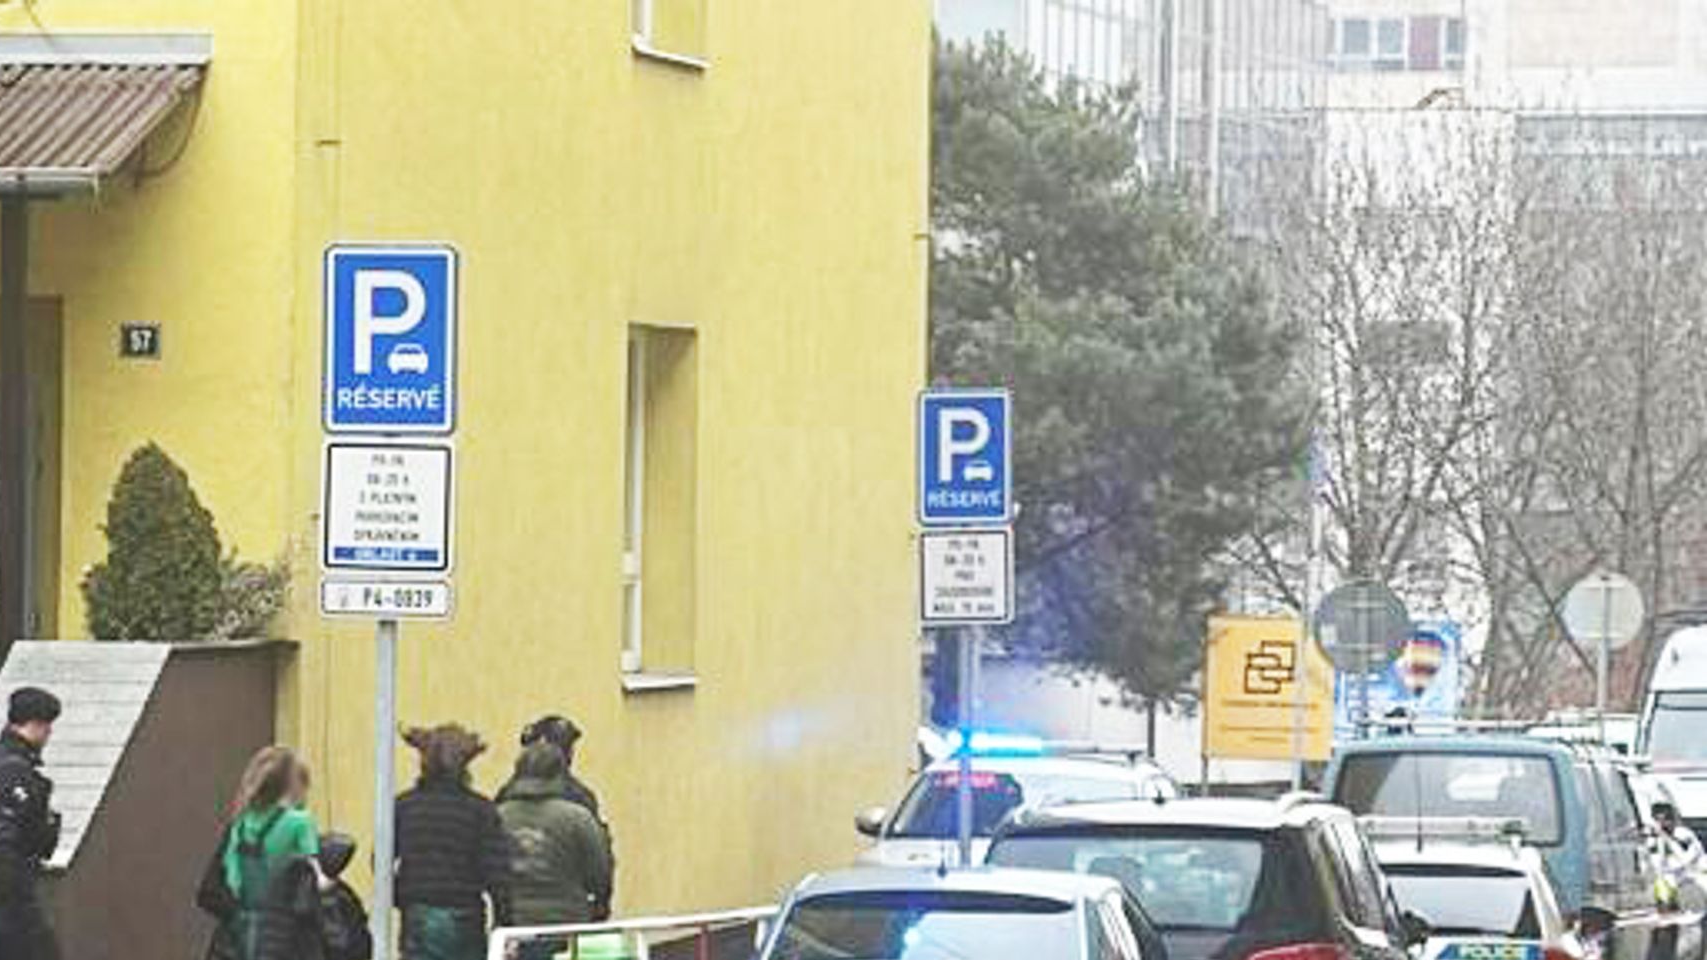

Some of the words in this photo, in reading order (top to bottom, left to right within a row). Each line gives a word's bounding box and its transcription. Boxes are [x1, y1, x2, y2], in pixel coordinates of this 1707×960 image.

[354, 269, 426, 374] P
[337, 379, 442, 411] RÉSERVÉ
[939, 408, 990, 481] P
